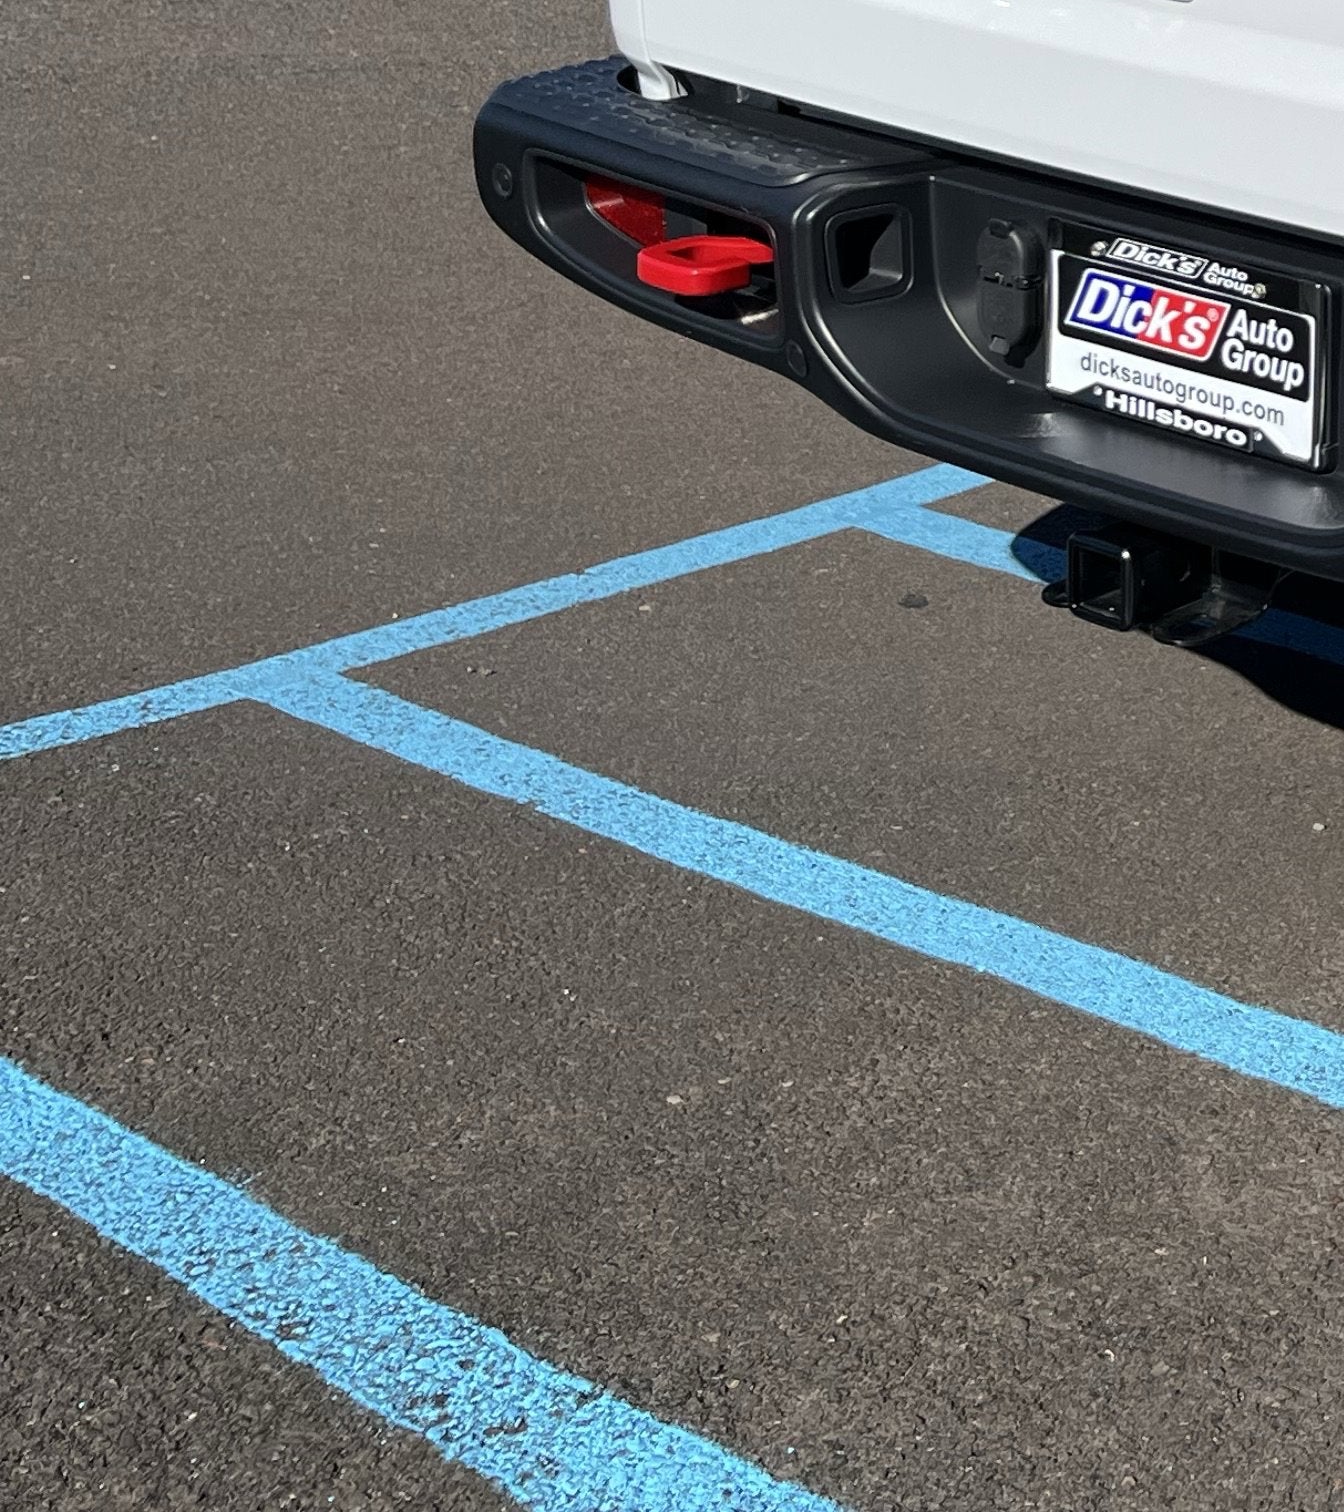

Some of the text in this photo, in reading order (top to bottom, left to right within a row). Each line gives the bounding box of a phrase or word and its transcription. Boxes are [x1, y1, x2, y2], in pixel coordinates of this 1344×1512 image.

[1112, 240, 1201, 275] Dick's
[1207, 262, 1249, 282] Auto
[1203, 271, 1255, 295] Group
[1075, 277, 1212, 350] Dick's
[1227, 308, 1294, 353] Auto
[1221, 338, 1305, 391] Group
[1080, 352, 1286, 427] dicksautogroup.com
[1104, 389, 1248, 446] Hillsboro
